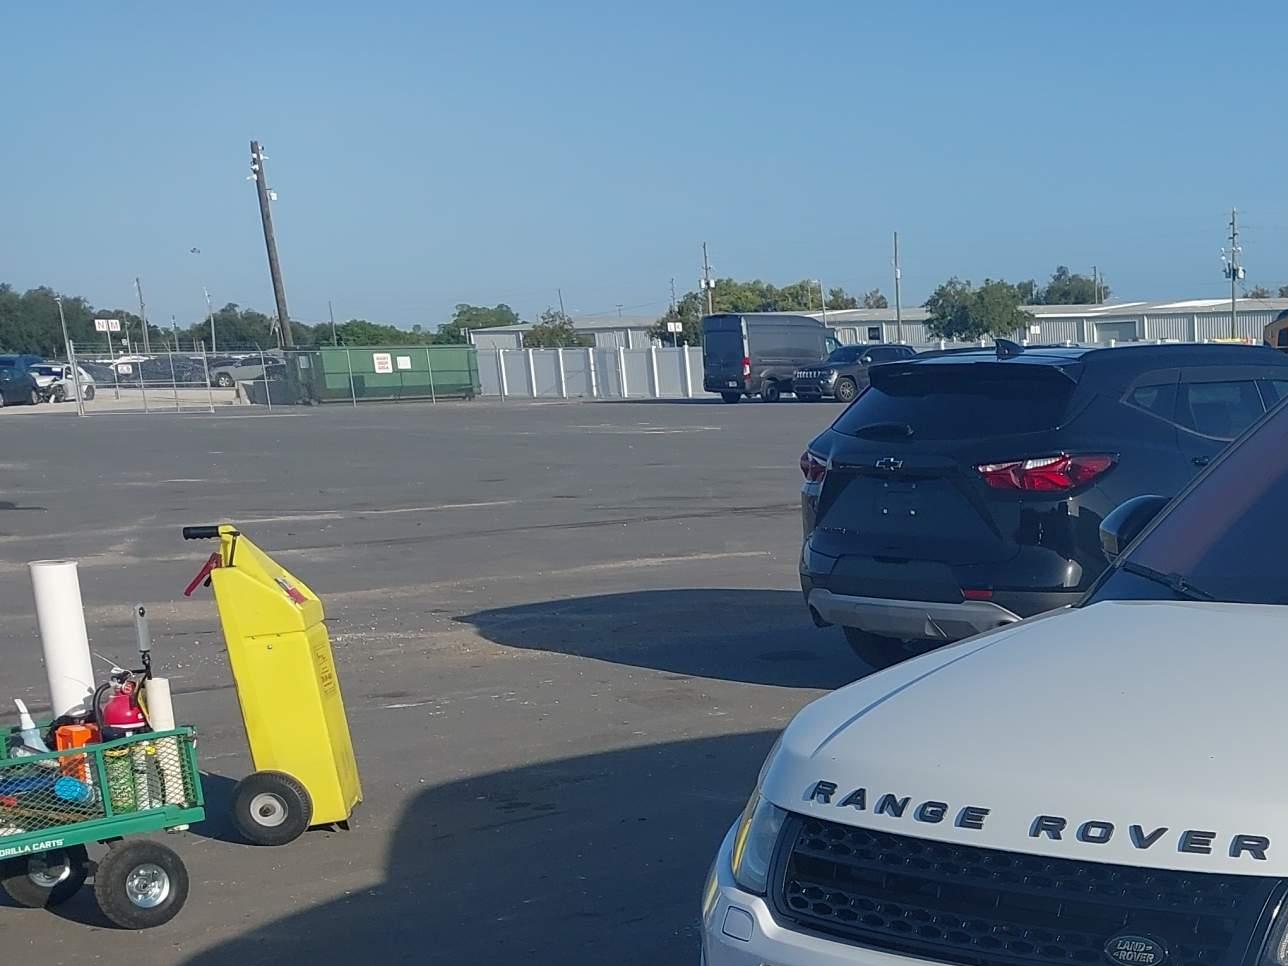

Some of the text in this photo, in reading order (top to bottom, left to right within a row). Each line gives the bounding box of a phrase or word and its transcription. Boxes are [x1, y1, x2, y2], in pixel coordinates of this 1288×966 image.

[803, 779, 1272, 861] RANGE ROVER
[32, 839, 64, 850] CARTS
[1117, 940, 1146, 952] LAND
[1119, 951, 1155, 963] ROVER
